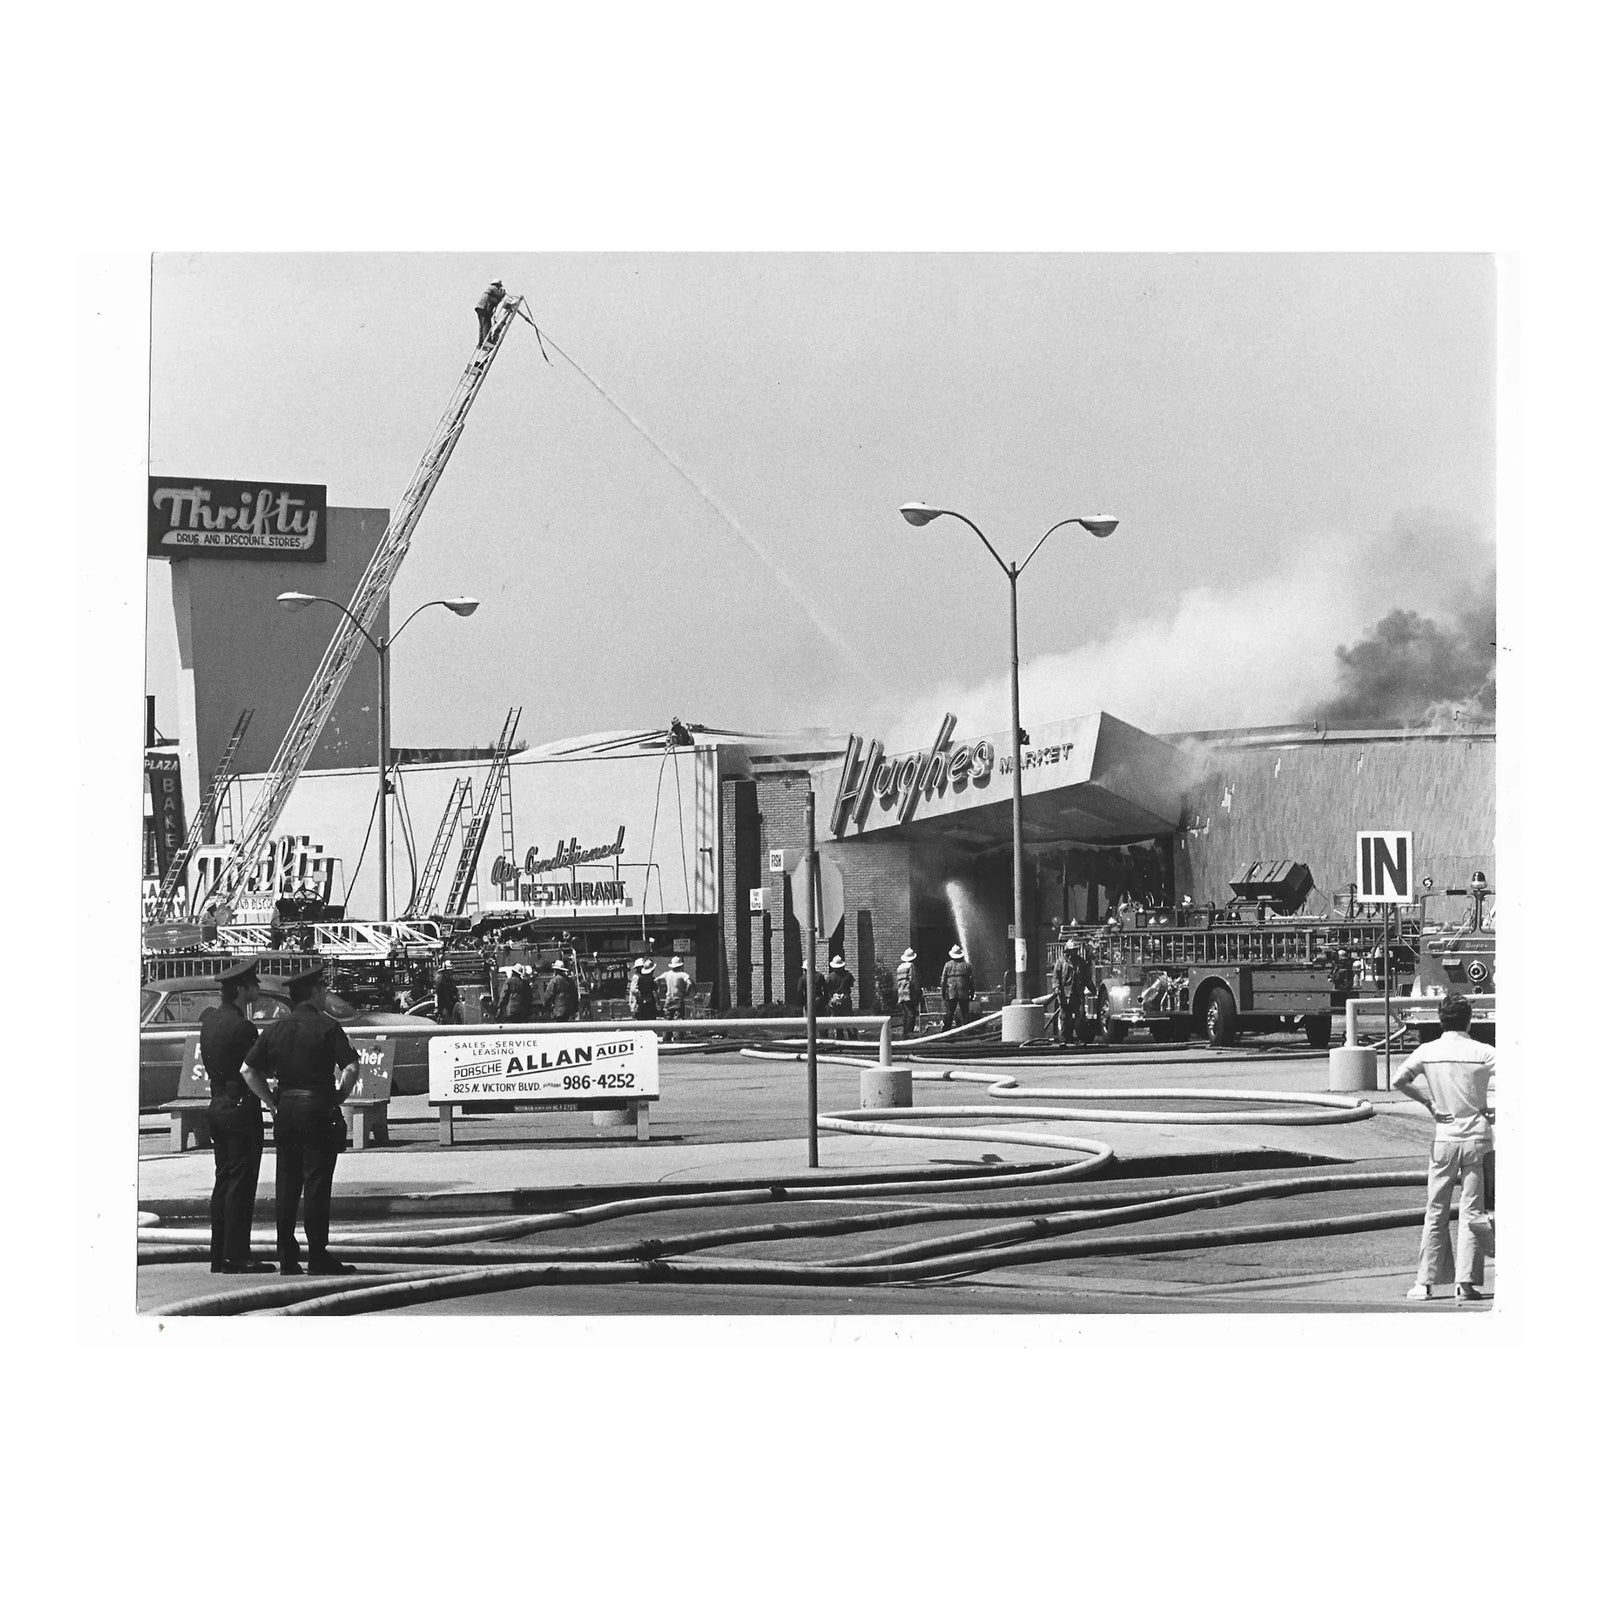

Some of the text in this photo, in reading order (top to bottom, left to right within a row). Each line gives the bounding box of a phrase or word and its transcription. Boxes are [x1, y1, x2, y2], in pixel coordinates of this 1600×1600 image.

[153, 486, 318, 550] Thrifty
[176, 532, 301, 547] DRUG AND DISCOUNT STORES
[144, 759, 178, 771] PLAZA
[830, 712, 1074, 836] Hughes MRKET
[491, 825, 625, 885] Air Conditioned
[1361, 837, 1408, 896] IN
[520, 881, 626, 902] RESTAURANT
[454, 1040, 538, 1050] SALES SERVICE
[472, 1048, 515, 1056] LEASING
[454, 1043, 635, 1079] PORSCHE ALLAN AUDI
[453, 1084, 470, 1094] 825
[482, 1083, 516, 1093] VICTORY
[563, 1073, 635, 1090] 986-4252
